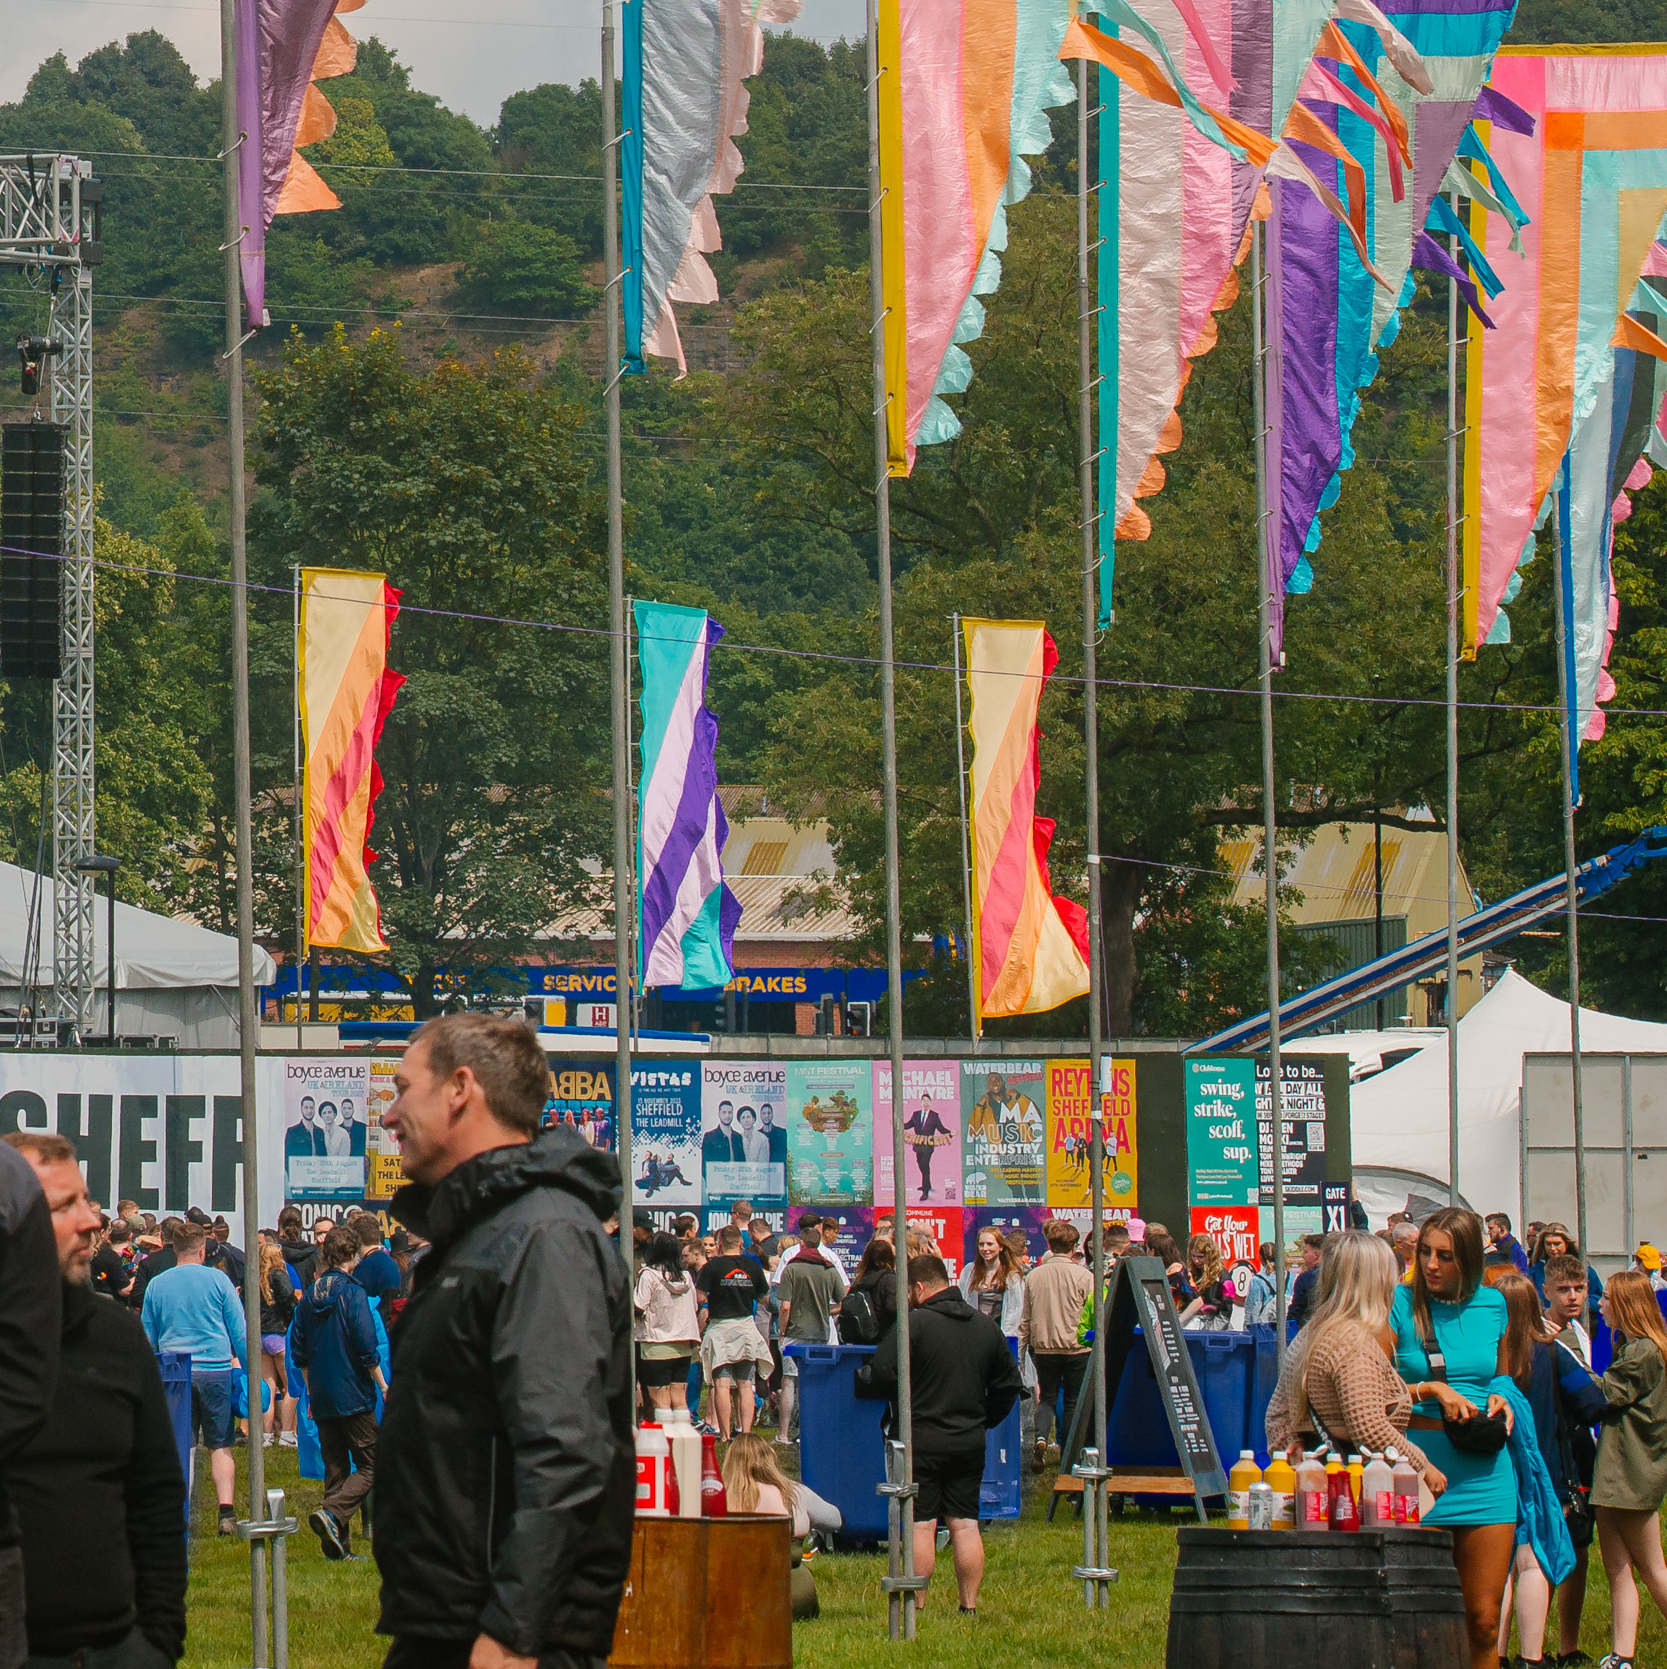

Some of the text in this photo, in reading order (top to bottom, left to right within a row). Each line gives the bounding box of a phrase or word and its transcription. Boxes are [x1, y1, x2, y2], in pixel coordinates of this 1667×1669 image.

[543, 975, 655, 992] SERVIC
[723, 976, 807, 993] BRAKES
[595, 1007, 606, 1020] H
[287, 1064, 365, 1084] boyce avenue
[816, 1067, 865, 1075] FESTIVAL
[963, 1062, 1042, 1075] WATERBEAR
[1200, 1064, 1226, 1073] Clubhouse
[1256, 1064, 1324, 1078] Loe to be...
[630, 1071, 692, 1087] VISTAS
[704, 1067, 786, 1088] boyce avenue
[879, 1070, 954, 1086] MCHAEL
[307, 1081, 319, 1089] UK
[325, 1081, 364, 1090] IRELAND
[548, 1071, 612, 1101] ABBA
[725, 1085, 738, 1094] UK
[744, 1086, 785, 1095] IRELAND
[879, 1085, 954, 1100] MINTYRE
[1200, 1078, 1245, 1101] swing,
[1286, 1083, 1303, 1095] DAY
[1306, 1082, 1324, 1095] ALL
[636, 1104, 683, 1116] SHEFFIELD
[1053, 1099, 1131, 1117] SHEFELD
[1194, 1099, 1238, 1119] strike,
[1287, 1098, 1314, 1110] NIGHT
[999, 1101, 1043, 1124] MA
[635, 1117, 683, 1128] THE LEADMILL
[1208, 1119, 1246, 1140] scoff,
[1259, 1122, 1270, 1133] DJ
[966, 1123, 1043, 1144] MUSIC
[975, 1143, 1041, 1155] INDUSTRY
[1223, 1146, 1253, 1164] sup.
[336, 1160, 358, 1168] August
[966, 1154, 1044, 1166] ENTERPRISE
[377, 1171, 393, 1180] THE
[755, 1166, 777, 1174] August
[311, 1176, 342, 1184] Sheffield
[1325, 1187, 1346, 1200] GATE
[767, 1212, 785, 1232] PIE
[1205, 1215, 1249, 1237] Get Your
[1326, 1205, 1346, 1232] X1
[1234, 1233, 1255, 1260] WET
[1238, 1271, 1247, 1292] 8
